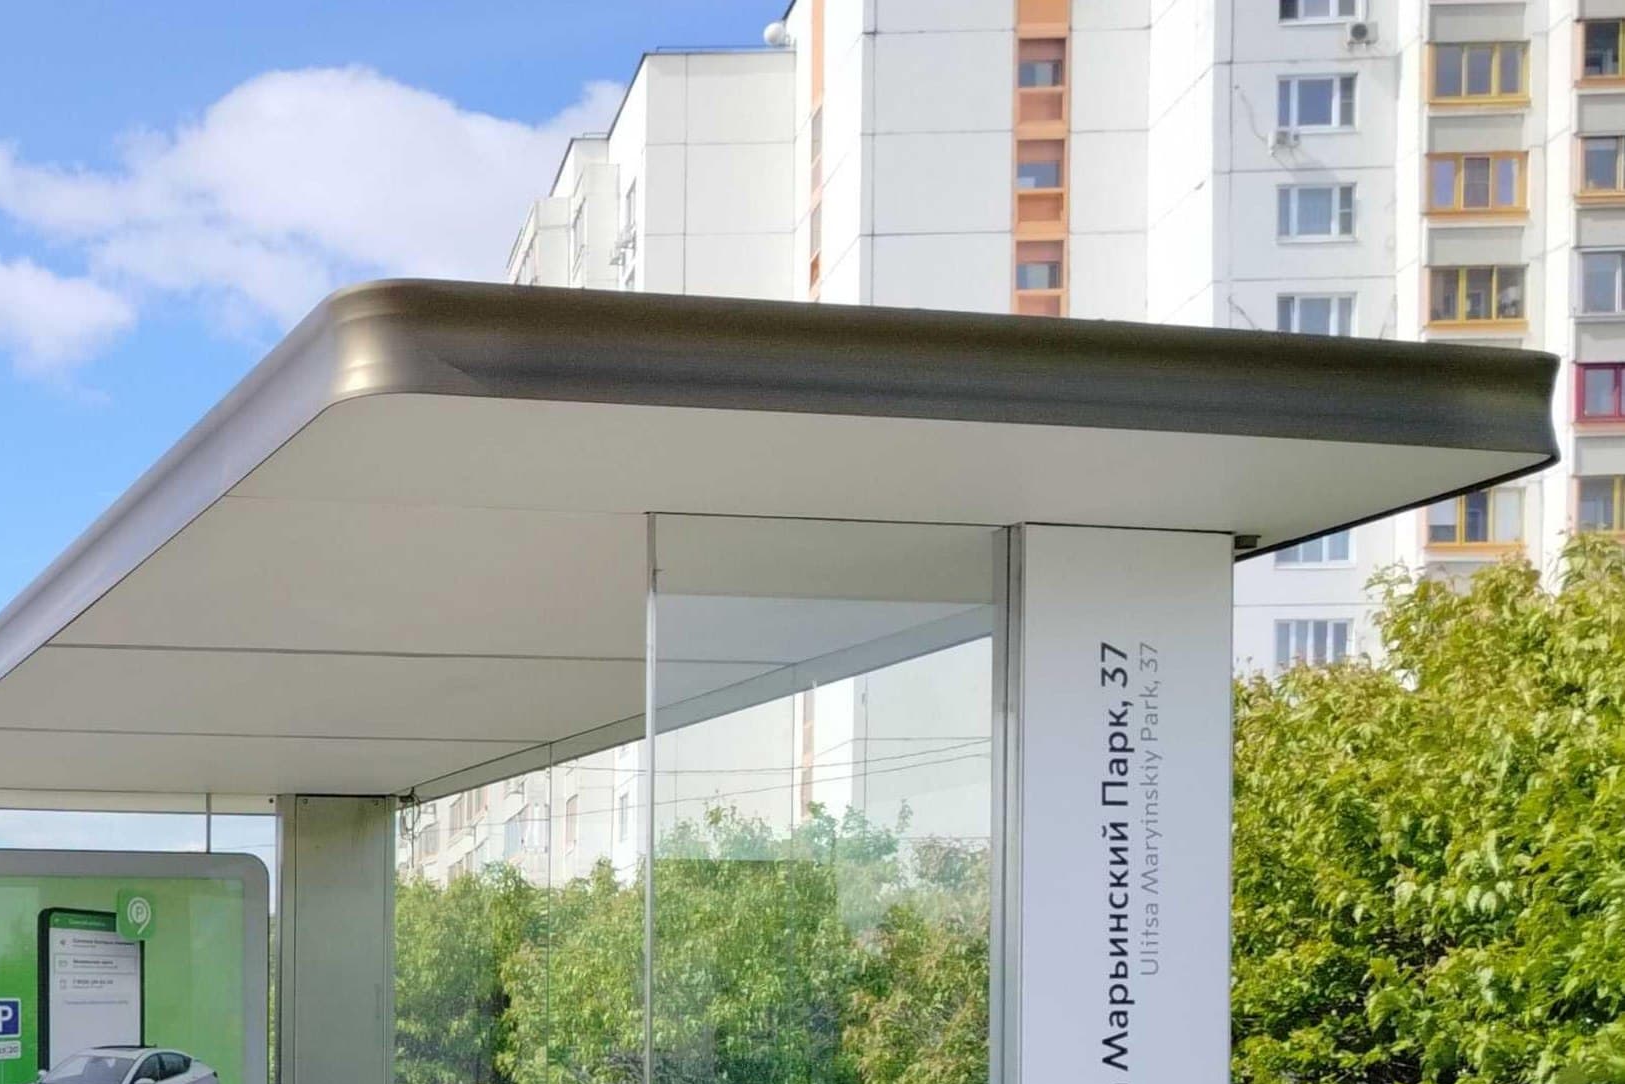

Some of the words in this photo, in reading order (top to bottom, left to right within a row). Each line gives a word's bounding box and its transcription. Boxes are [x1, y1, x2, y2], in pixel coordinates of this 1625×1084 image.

[1101, 642, 1128, 688] 37
[1139, 642, 1158, 672] 37
[1139, 680, 1161, 741] Park,
[1101, 700, 1135, 806] Парк,
[1140, 750, 1162, 895] Maryinskiy
[1102, 822, 1135, 1071] Марьинский
[1140, 902, 1159, 975] Ulitsa
